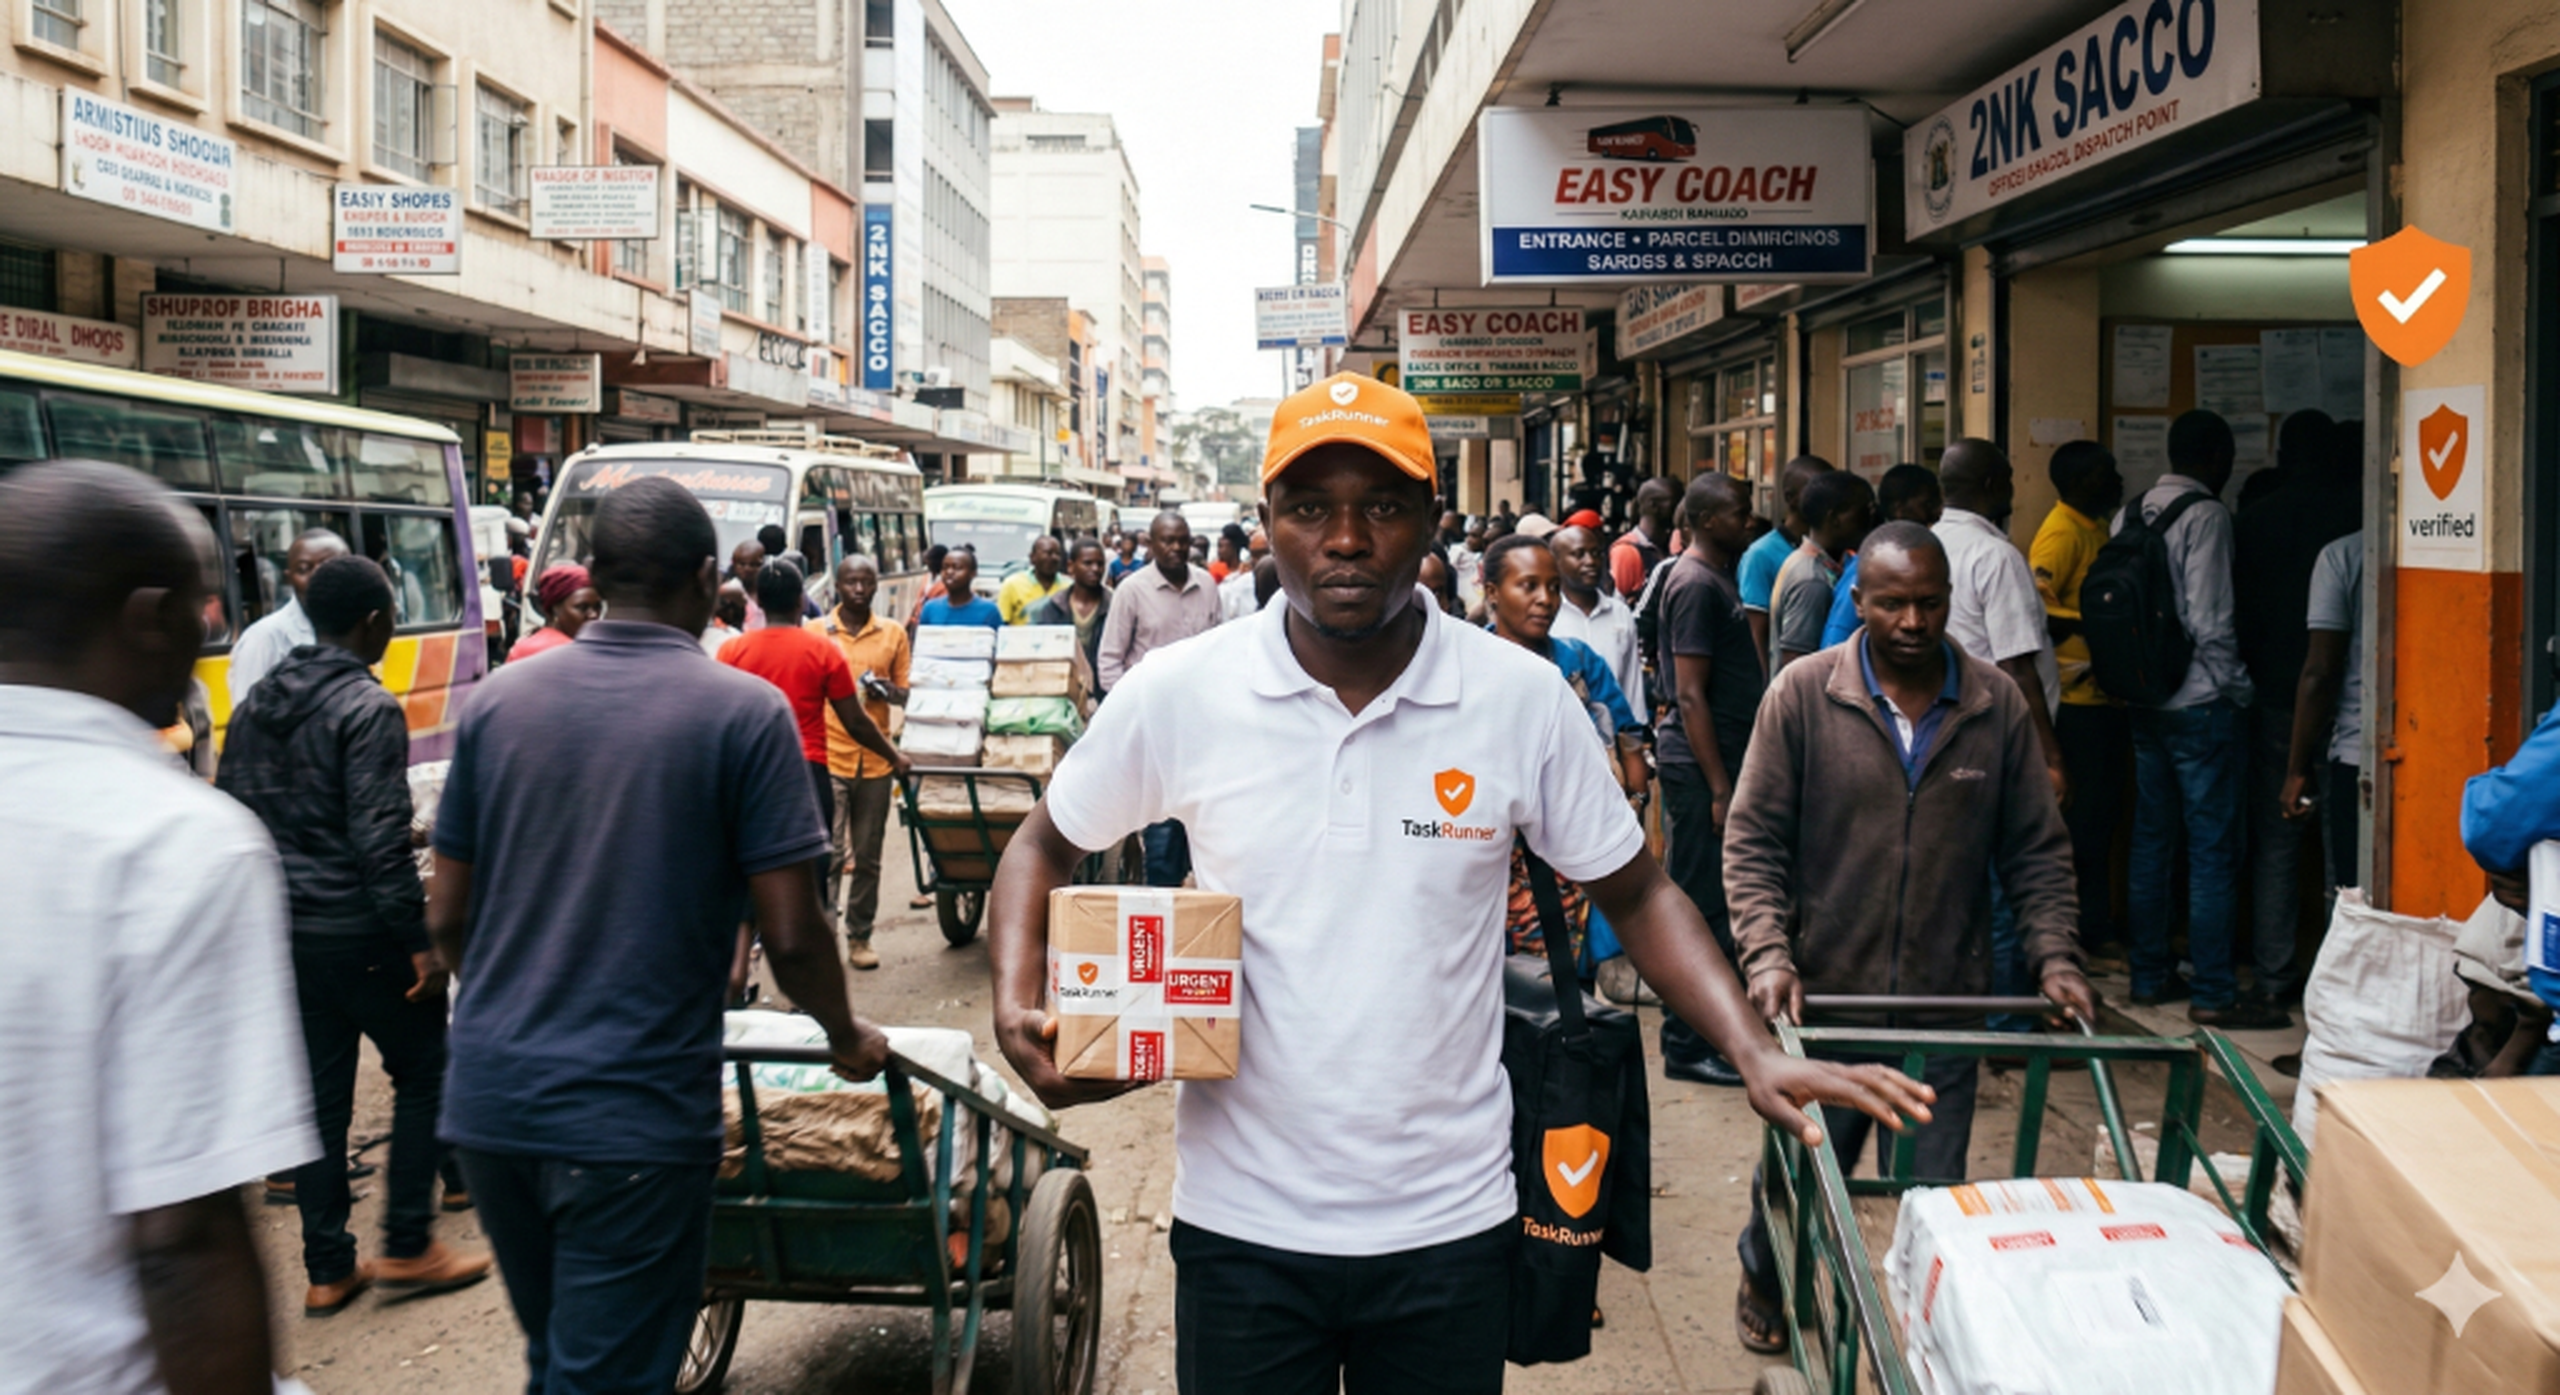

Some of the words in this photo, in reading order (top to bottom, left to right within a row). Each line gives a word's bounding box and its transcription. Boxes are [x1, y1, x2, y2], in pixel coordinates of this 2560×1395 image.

[1970, 66, 2041, 181] 2NK
[2053, 0, 2216, 139] SACCO
[2136, 99, 2180, 136] POINT
[1554, 167, 1665, 204] EASY
[1676, 166, 1818, 204] COACH
[869, 224, 889, 277] 2NK
[1519, 233, 1626, 249] ENTRANCE
[1648, 231, 1726, 247] PARCEL
[1673, 255, 1686, 269] &
[1692, 253, 1773, 269] SPACCH
[147, 298, 240, 317] SHUPROF
[247, 300, 323, 318] BRIGHA
[869, 284, 889, 372] SACCO
[1408, 313, 1477, 335] EASY
[1486, 312, 1578, 334] COACH
[1507, 376, 1555, 389] SACCO
[2409, 512, 2476, 538] verified
[1401, 819, 1497, 840] TaskRunner
[1132, 919, 1146, 979] URGENT
[1169, 974, 1229, 988] URGENT
